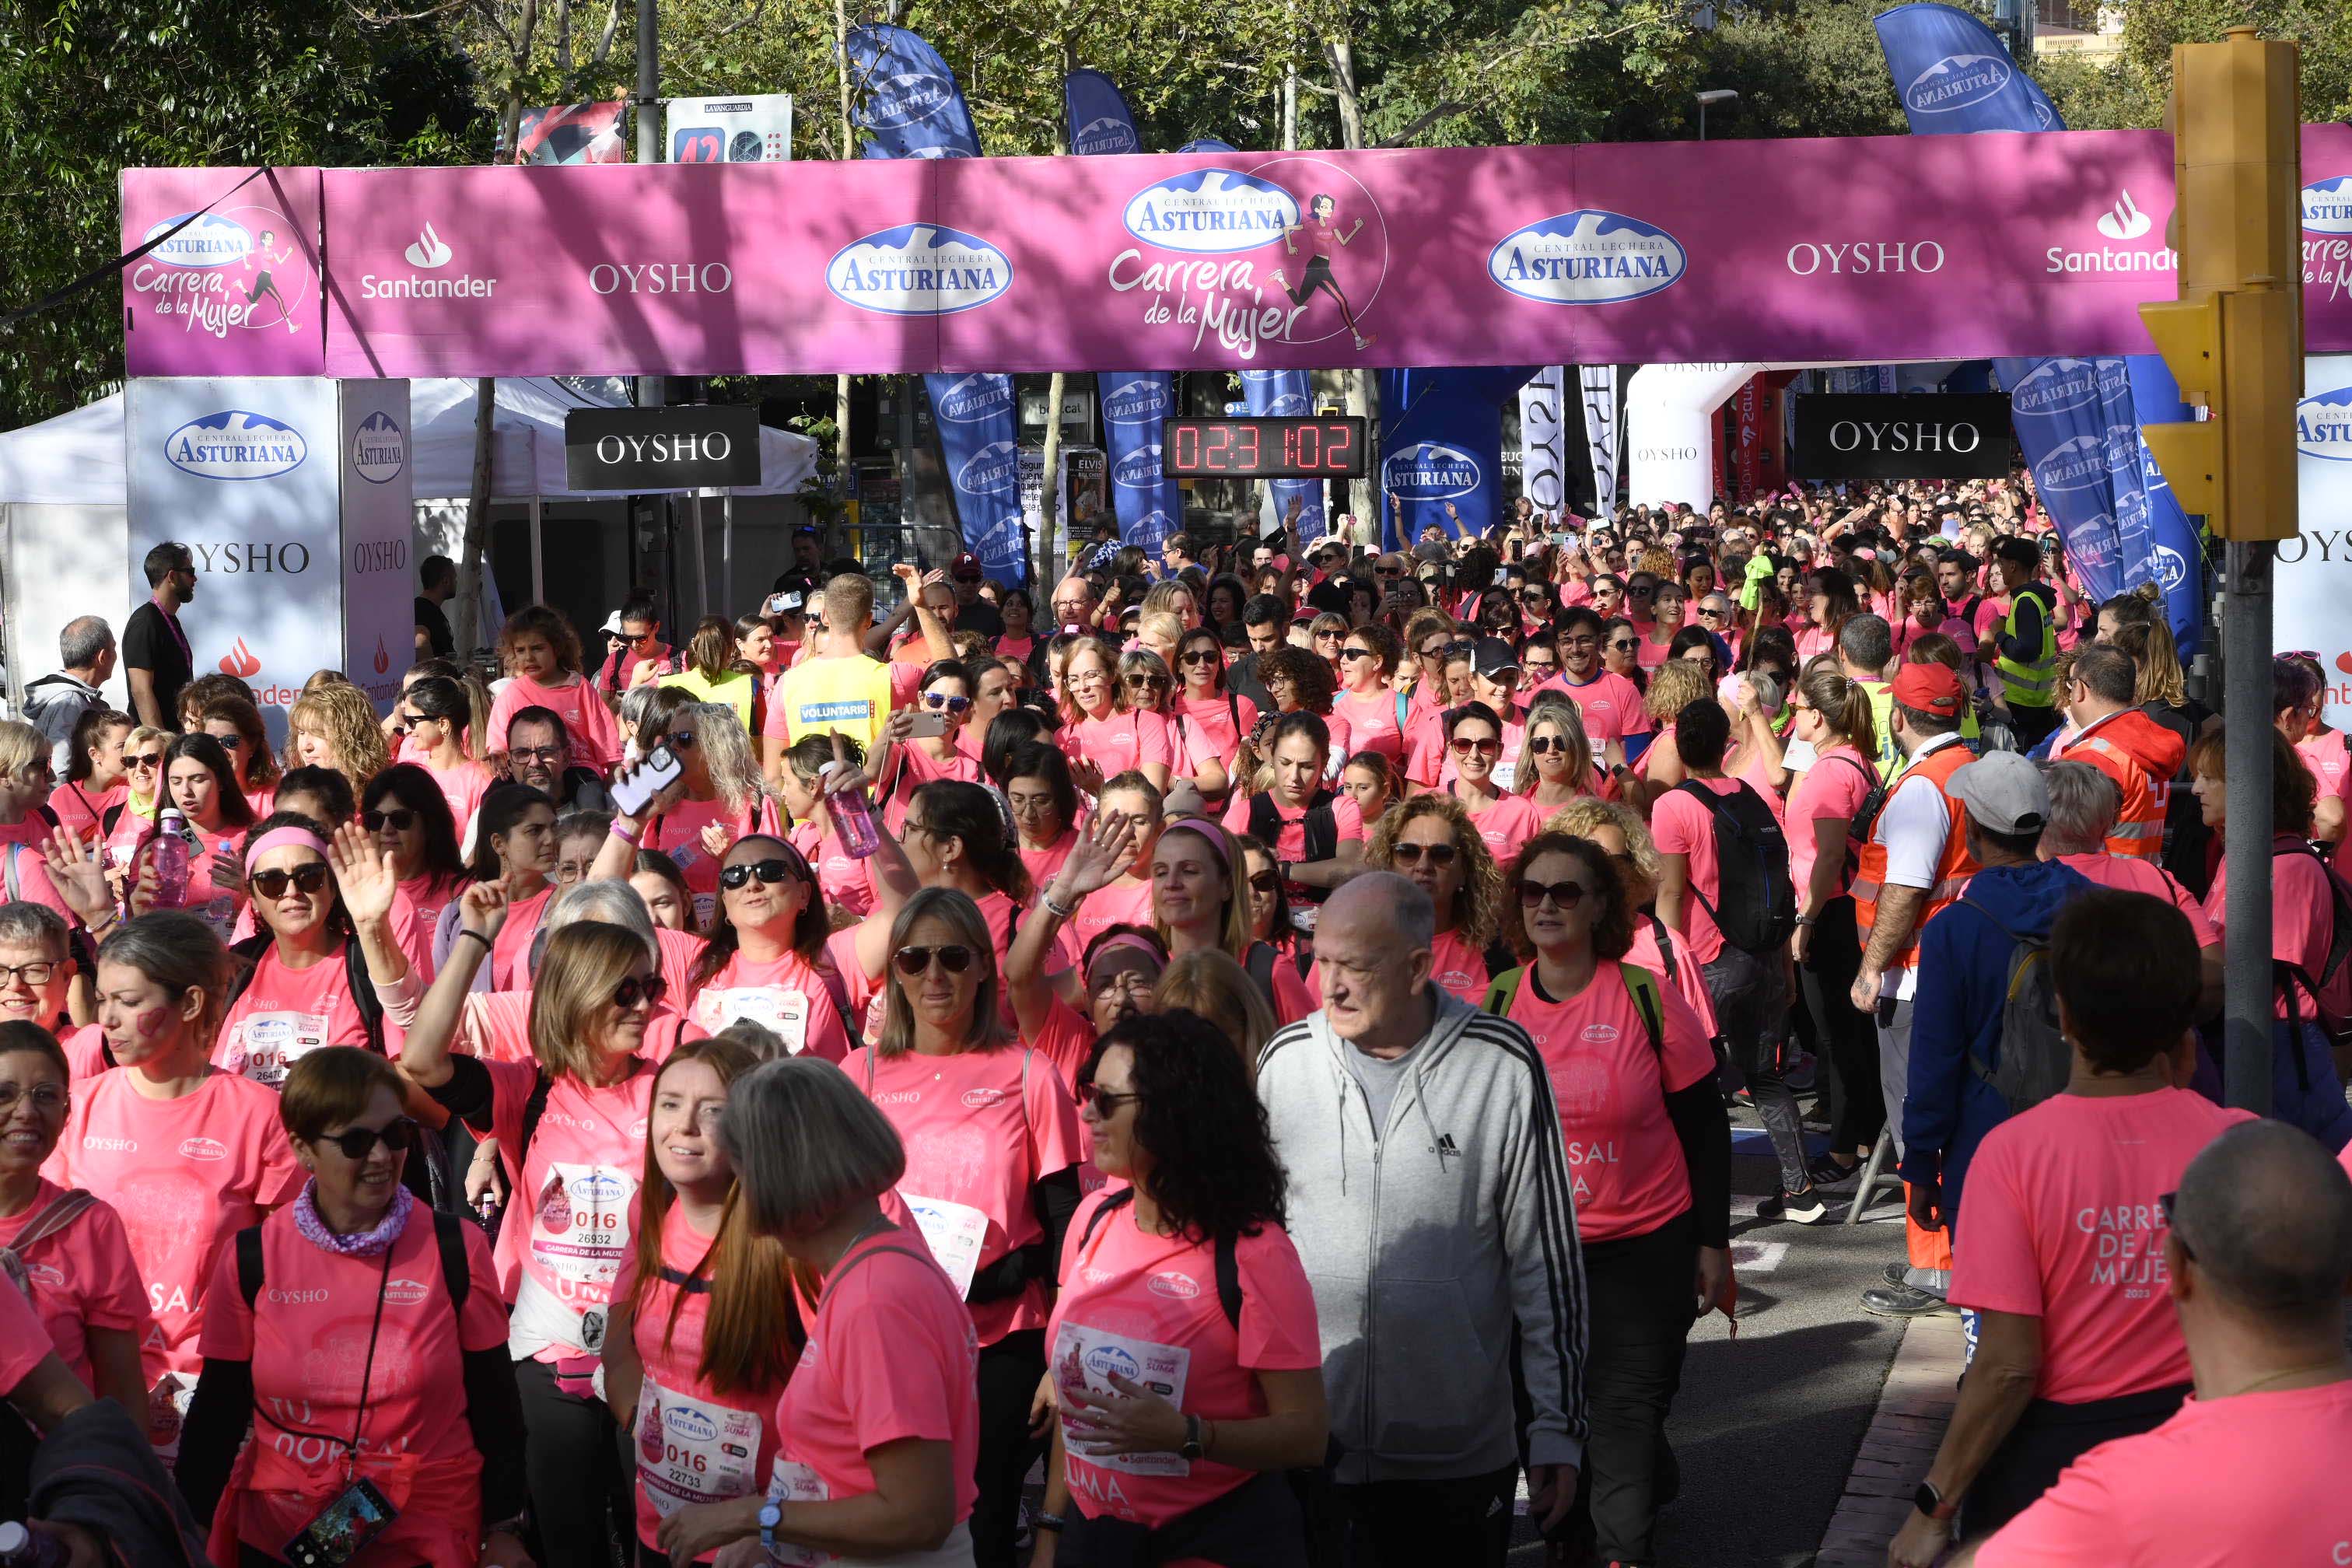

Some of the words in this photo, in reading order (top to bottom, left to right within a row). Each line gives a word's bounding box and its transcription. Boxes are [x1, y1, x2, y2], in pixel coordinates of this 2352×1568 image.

[1138, 200, 1286, 232] ASTURIANA
[152, 233, 244, 253] ASTURIANA
[1535, 243, 1594, 253] CENTRAL
[1601, 241, 1665, 252] LECHERA
[869, 255, 927, 264] CENTRAL
[1109, 248, 1255, 292] Carrera
[1503, 246, 1671, 281] ASTURIANA
[1787, 240, 1944, 275] OYSHO
[2046, 247, 2179, 274] Santande
[133, 263, 226, 292] Carrera
[362, 274, 497, 299] Santander
[589, 262, 733, 294] OYSHO
[841, 257, 999, 292] ASTURIANA
[156, 294, 172, 314] de
[176, 294, 188, 314] la
[186, 289, 259, 338] Mujer
[1144, 293, 1170, 325] de
[1177, 294, 1196, 324] la
[1192, 286, 1309, 360] Mujer
[176, 437, 297, 464] ASTURIANA
[597, 432, 731, 464] OYSHO
[1829, 422, 1979, 453] OYSHO
[357, 439, 401, 465] ASTURIANA
[1078, 460, 1102, 469] ELVIS
[1638, 446, 1697, 461] OYSHO
[1384, 466, 1473, 489] ASTURIANA
[173, 542, 310, 574] YSHO
[354, 539, 405, 574] OYSHO
[2273, 530, 2352, 563] OYS
[801, 705, 869, 720] VOLUNTARIS
[1083, 914, 1116, 926] OYSHO
[246, 993, 278, 1011] YSHO
[252, 1052, 287, 1068] 016
[257, 1070, 282, 1080] 26470
[83, 1136, 138, 1153] OYSHO
[1428, 1146, 1462, 1157] adas
[1568, 1140, 1619, 1166] SAL
[575, 1181, 622, 1197] ASTURIANA
[576, 1212, 617, 1229] 016
[2077, 1204, 2167, 1234] CARRE
[545, 1244, 579, 1255] CARRERA
[580, 1248, 590, 1256] DE
[591, 1248, 601, 1257] LA
[602, 1249, 623, 1258] MUJE
[577, 1233, 611, 1244] 26932
[2099, 1233, 2136, 1258] DE
[2147, 1232, 2165, 1256] L
[2090, 1258, 2167, 1286] MUJE
[268, 1287, 330, 1305] OYSHO
[1088, 1356, 1136, 1377] ASTURIANA
[1145, 1362, 1175, 1375] SUMA
[268, 1396, 312, 1425] TU
[667, 1412, 713, 1439] ASTURIANA
[723, 1425, 751, 1438] SUMA
[667, 1444, 708, 1473] 016
[1129, 1454, 1178, 1465] Santander
[644, 1472, 671, 1494] CARRERA
[670, 1485, 682, 1497] DE
[681, 1489, 694, 1500] LA
[693, 1493, 722, 1504] MUJER
[669, 1468, 702, 1489] 22733
[1066, 1455, 1129, 1507] UMA
